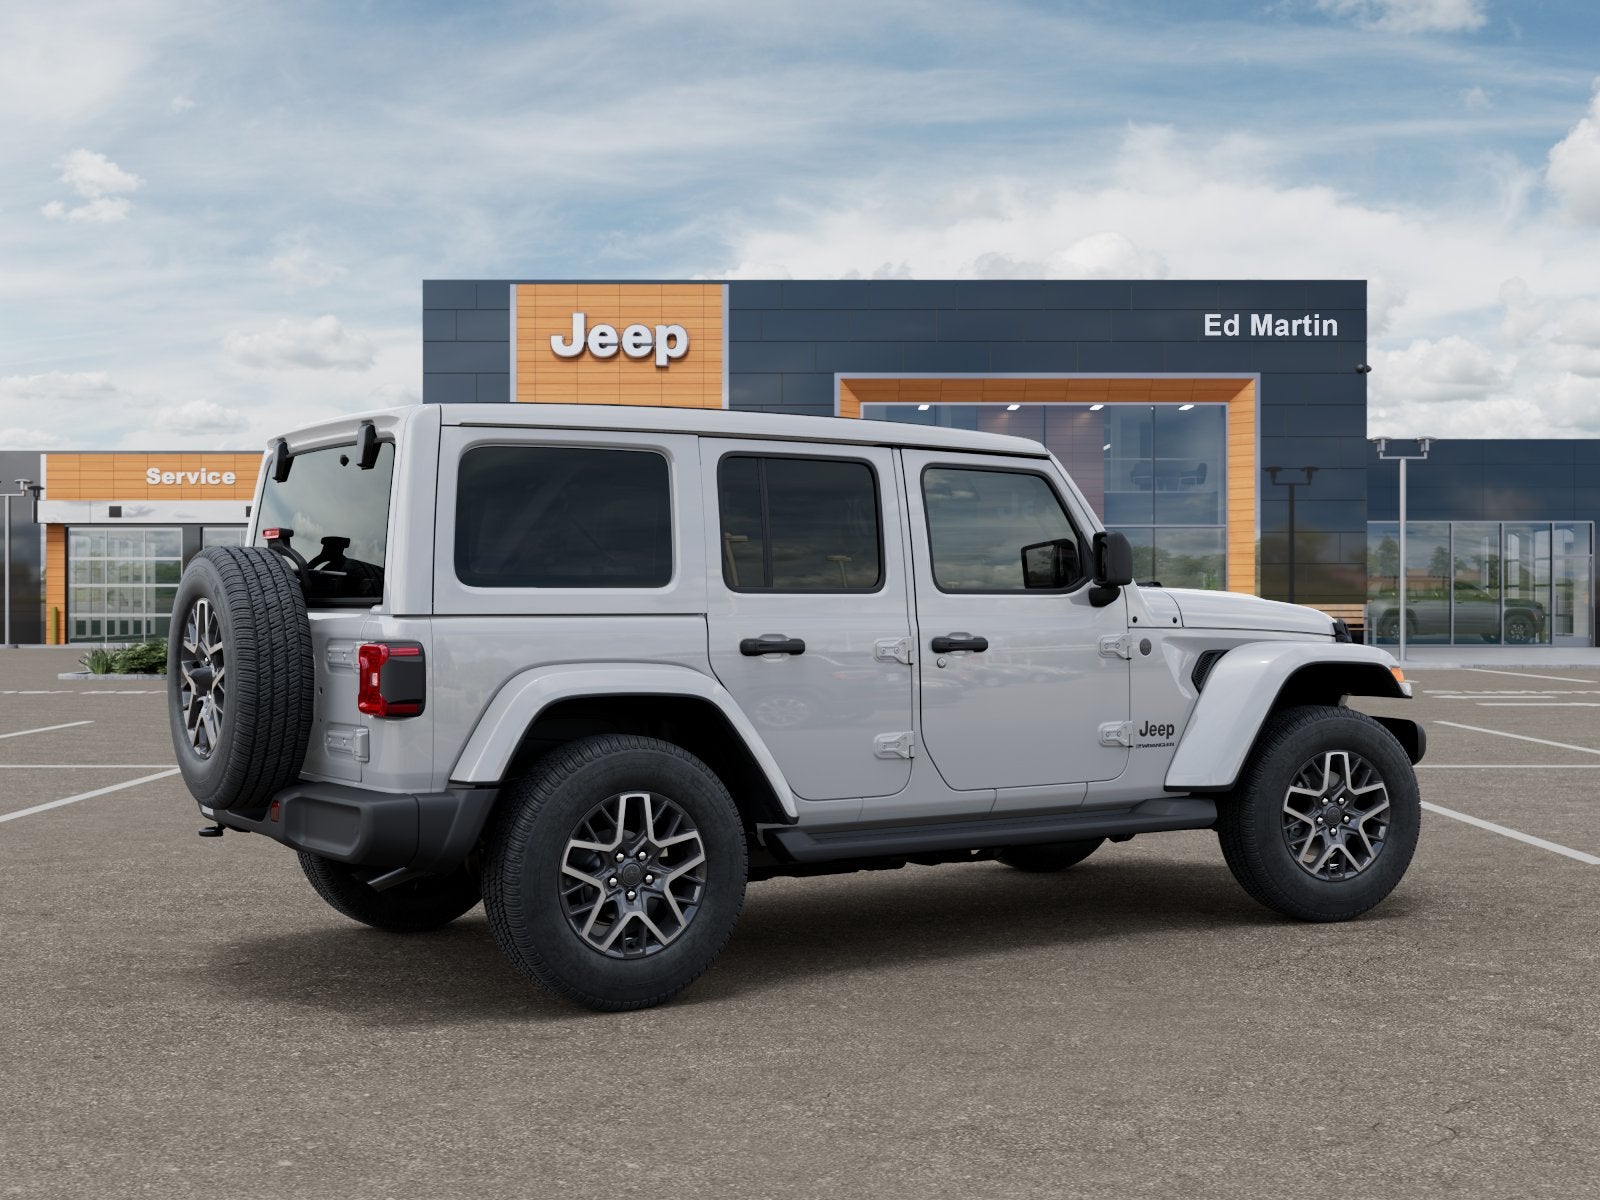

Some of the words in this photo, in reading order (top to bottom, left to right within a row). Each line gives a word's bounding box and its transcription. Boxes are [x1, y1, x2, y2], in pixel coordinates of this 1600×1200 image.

[1204, 313, 1240, 337] Ed
[1250, 313, 1338, 337] Martin
[550, 312, 689, 367] Jeep
[146, 467, 236, 485] Service
[1139, 720, 1175, 739] Jeep
